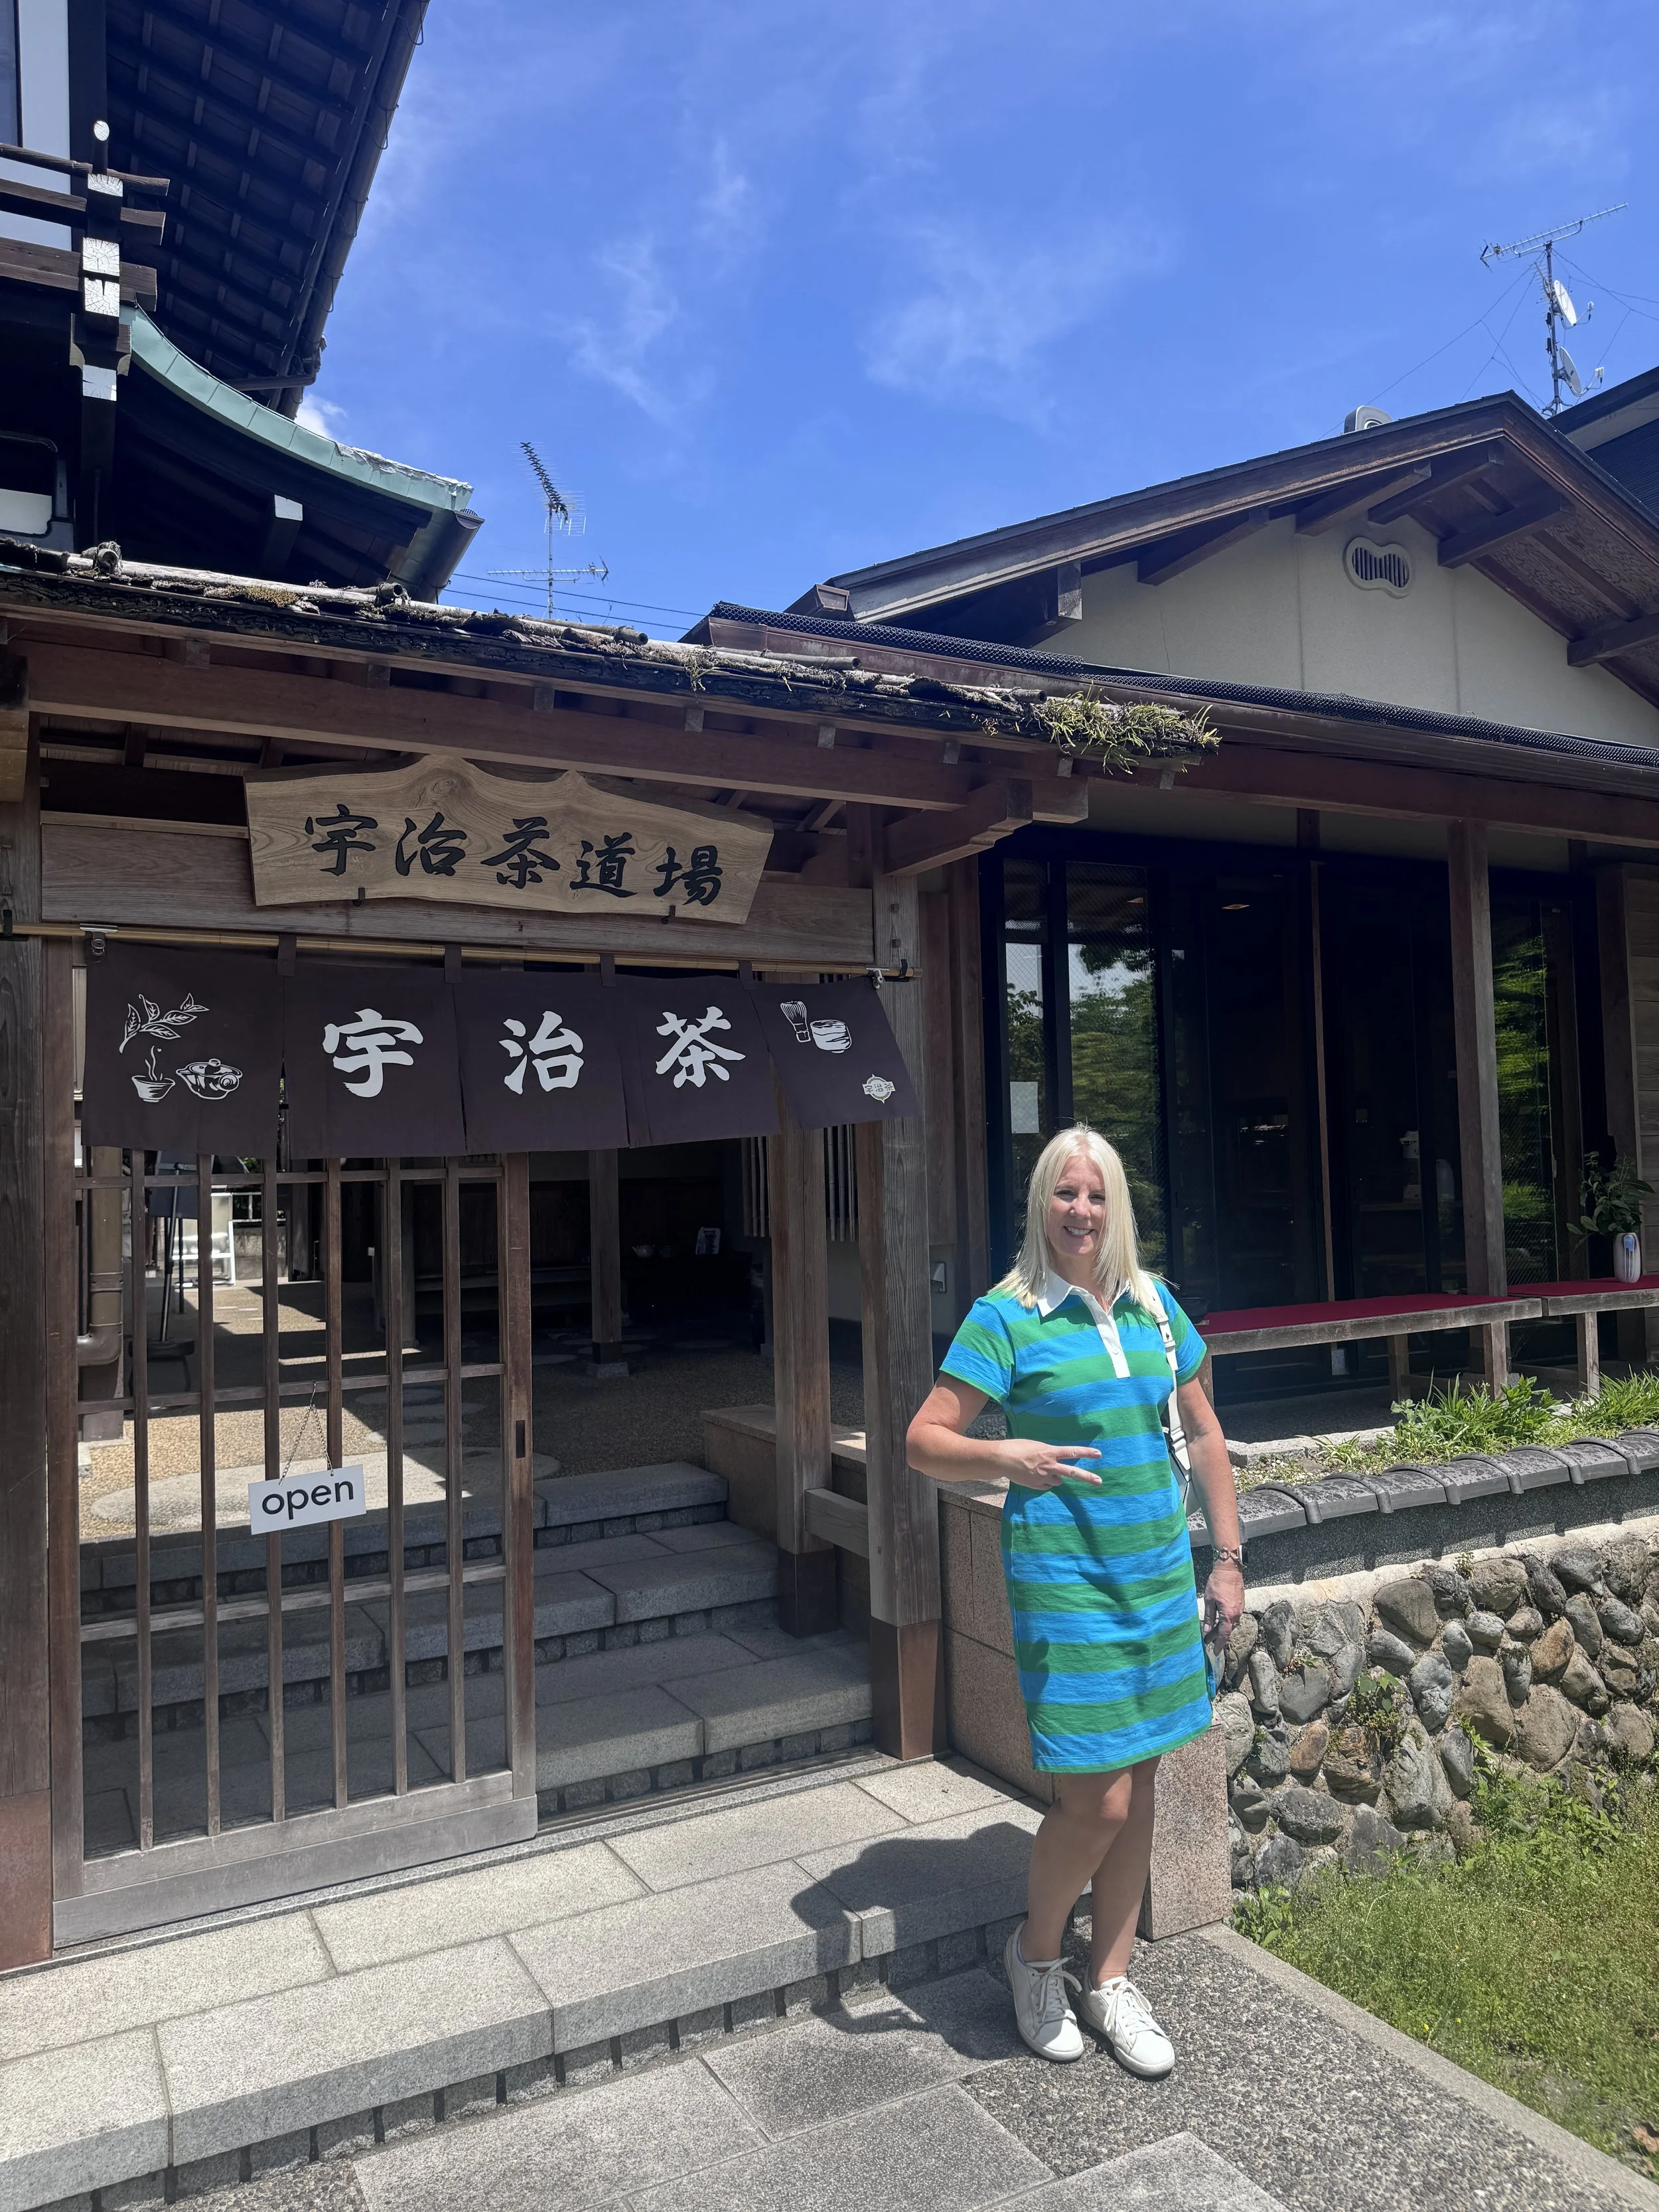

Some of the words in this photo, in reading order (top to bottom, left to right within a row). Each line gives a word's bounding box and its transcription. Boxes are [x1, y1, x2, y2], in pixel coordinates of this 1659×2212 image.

[305, 804, 721, 906] 宇治茶道場
[323, 1007, 747, 1098] 宇治茶
[262, 1481, 354, 1520] open
